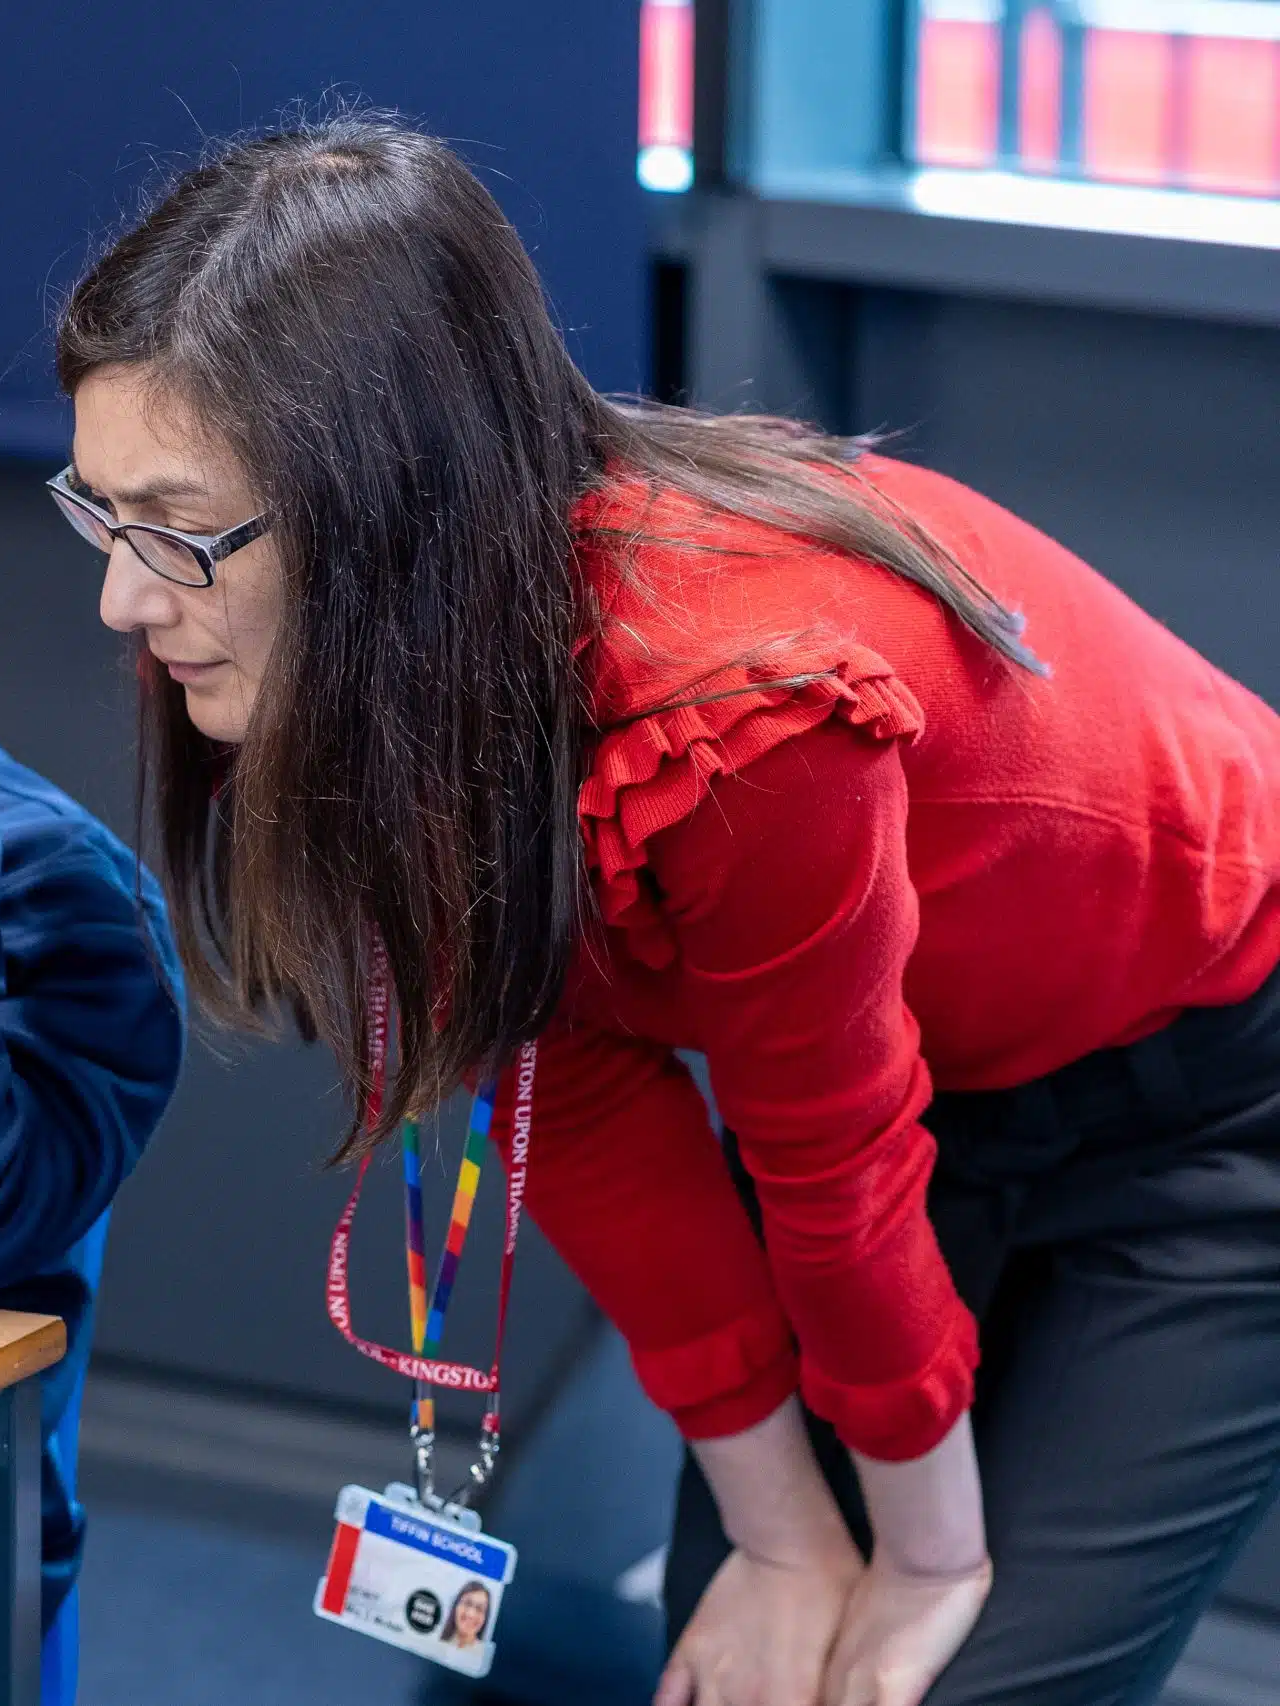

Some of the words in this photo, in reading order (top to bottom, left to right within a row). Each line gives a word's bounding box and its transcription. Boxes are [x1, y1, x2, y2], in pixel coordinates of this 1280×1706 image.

[518, 1042, 538, 1105] STON
[513, 1105, 532, 1163] UPON
[397, 1356, 494, 1389] KINGSTO
